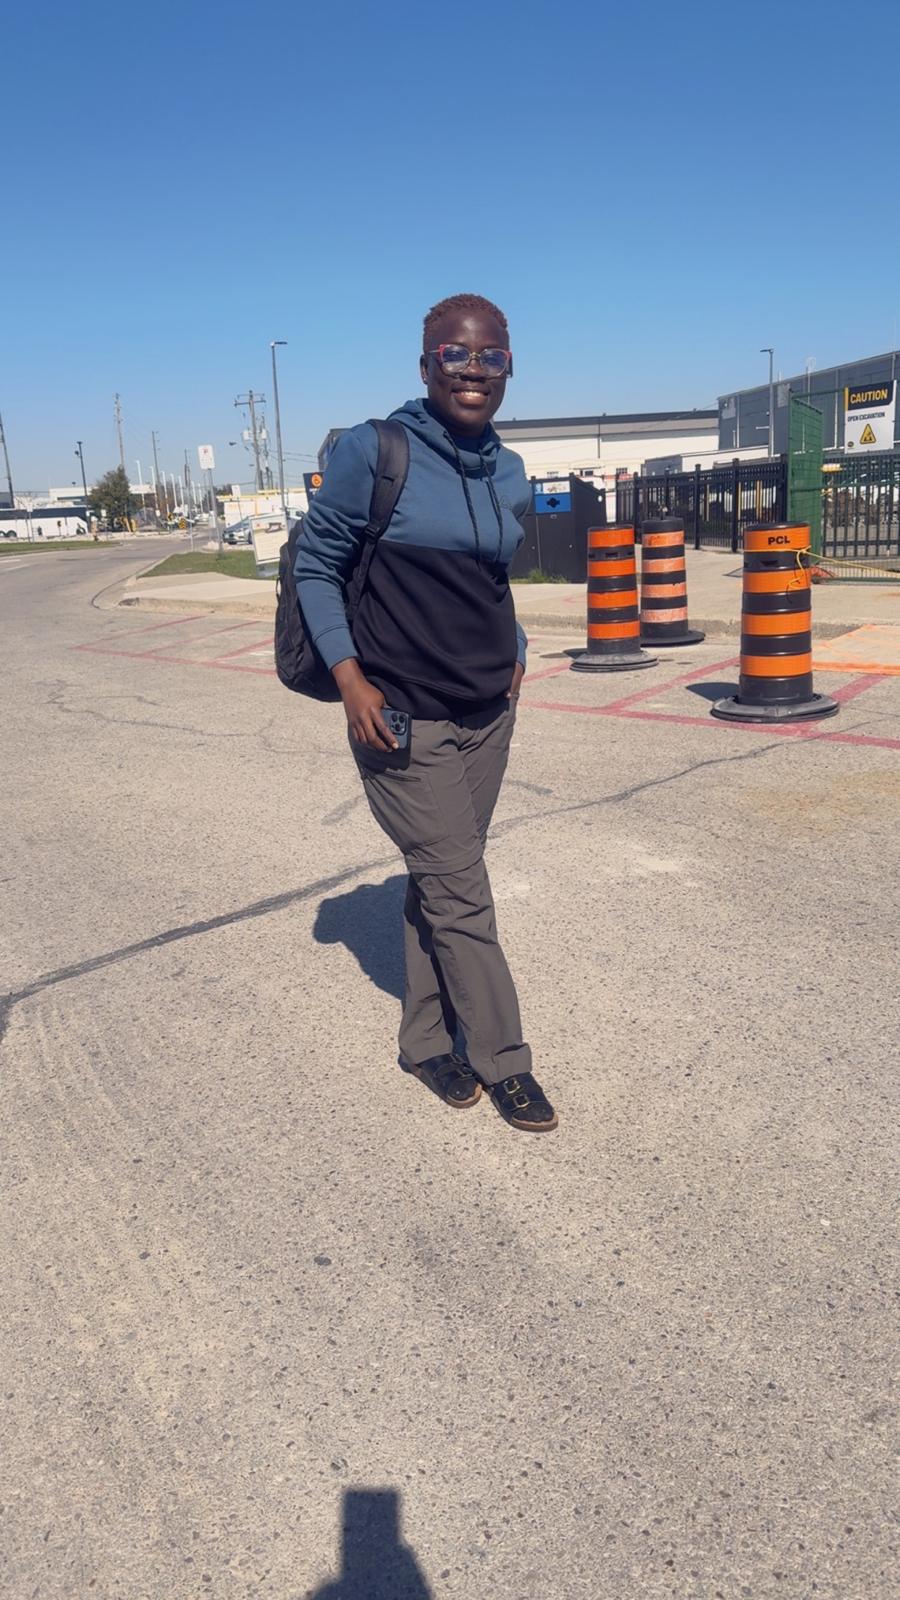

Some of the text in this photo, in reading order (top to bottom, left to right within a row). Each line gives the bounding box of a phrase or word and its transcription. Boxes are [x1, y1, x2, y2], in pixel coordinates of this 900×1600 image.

[850, 388, 888, 404] CAUTION
[860, 412, 885, 421] EXCAVATION
[768, 536, 790, 545] PCL
